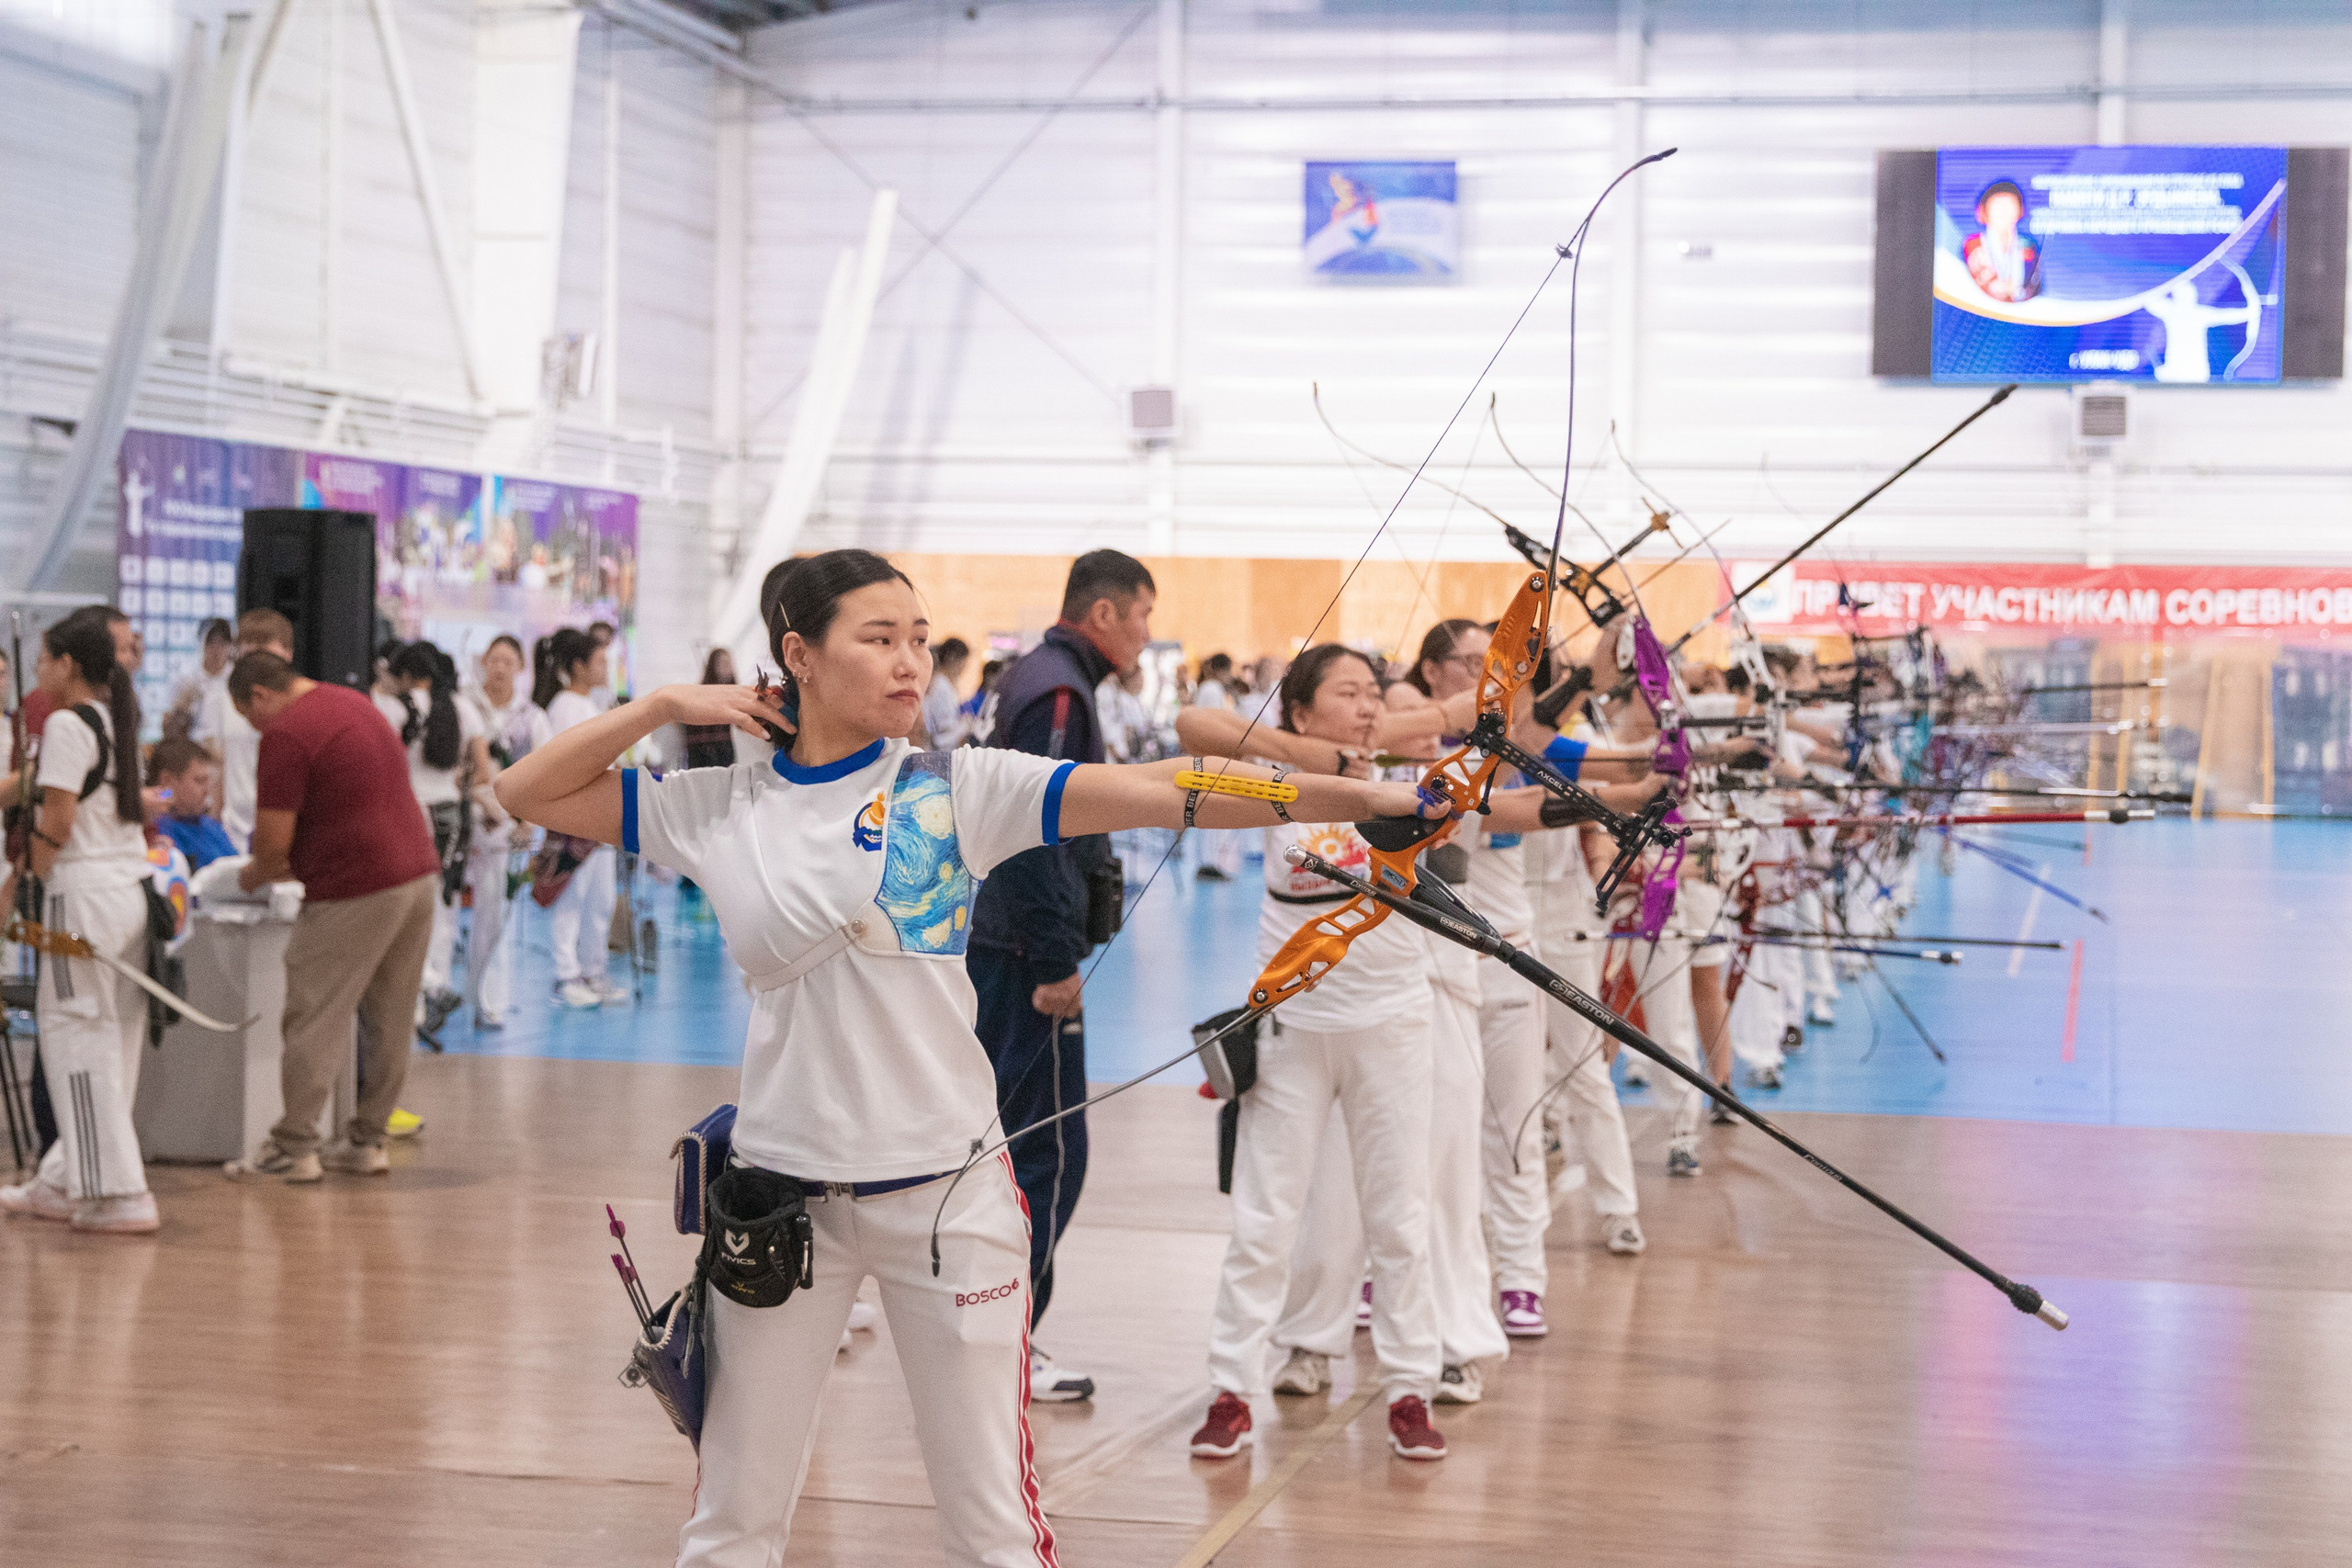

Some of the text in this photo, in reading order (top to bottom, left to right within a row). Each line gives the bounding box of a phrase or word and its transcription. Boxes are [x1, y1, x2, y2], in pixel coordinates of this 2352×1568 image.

[1930, 582, 2159, 625] УЧАСТНИКАМ
[1537, 771, 1563, 790] AXCEL
[1450, 920, 1477, 939] EASTON
[1566, 989, 1615, 1025] EASTON
[956, 1285, 1012, 1306] BOSCO
